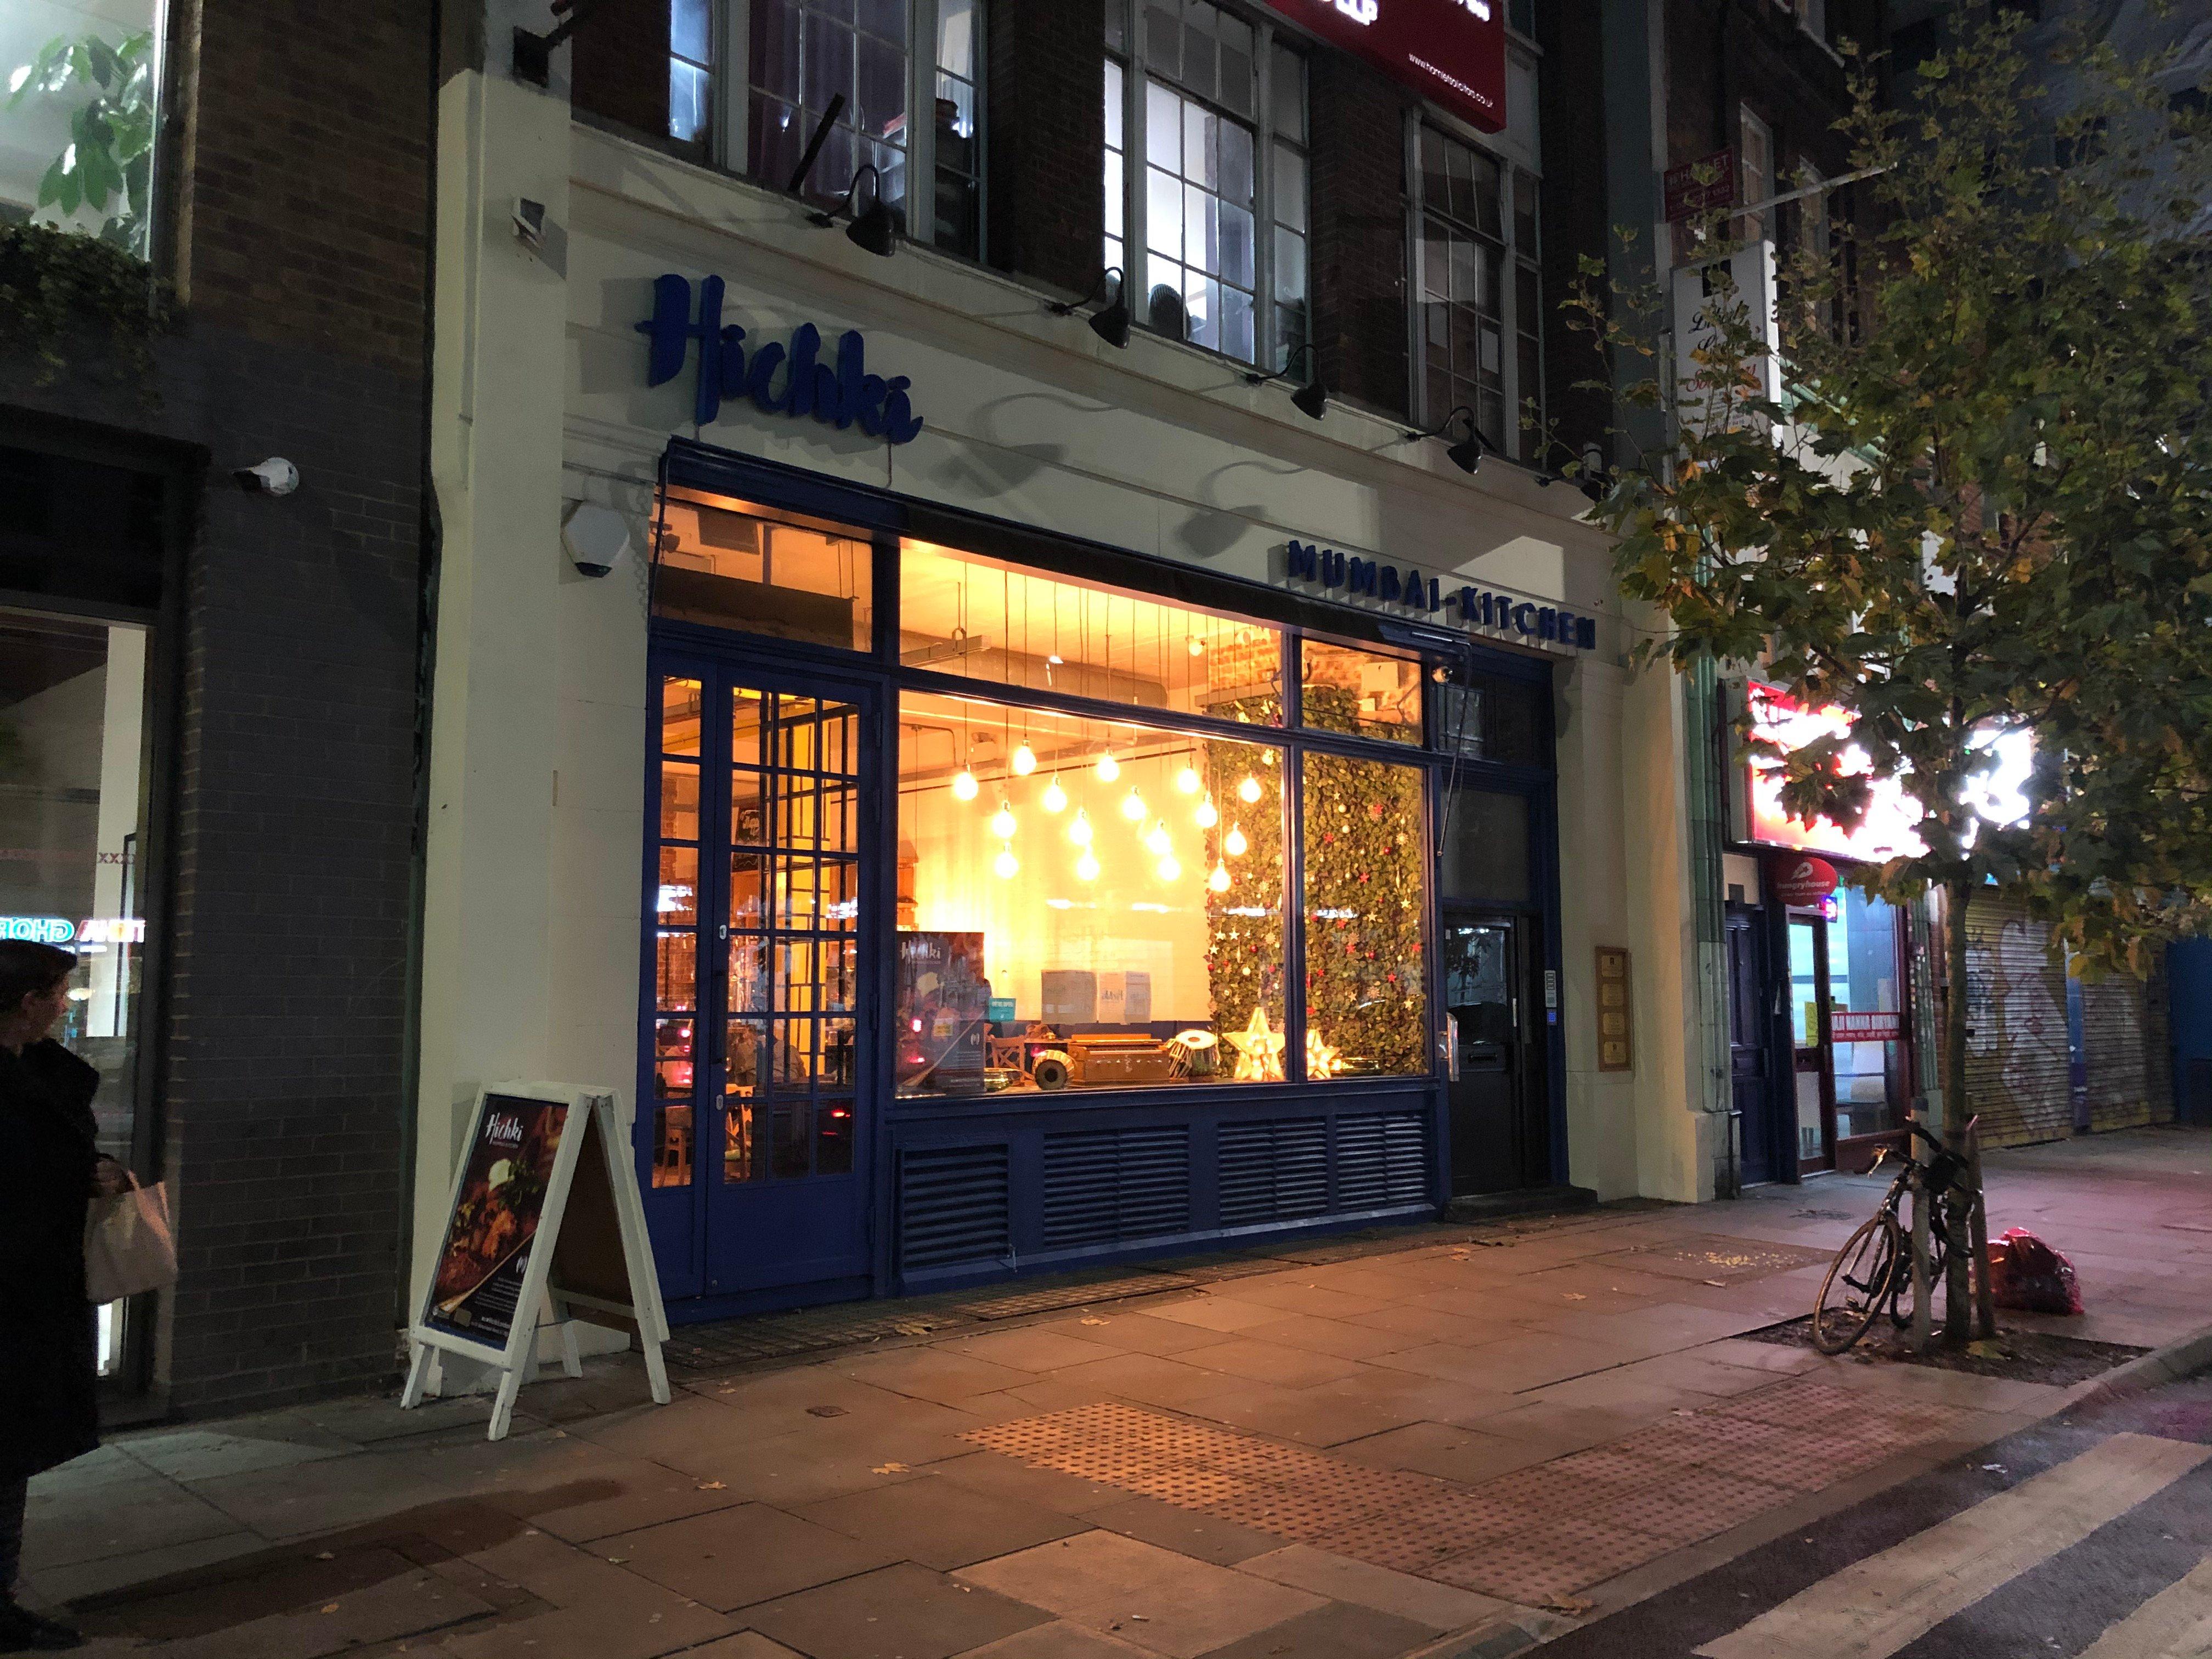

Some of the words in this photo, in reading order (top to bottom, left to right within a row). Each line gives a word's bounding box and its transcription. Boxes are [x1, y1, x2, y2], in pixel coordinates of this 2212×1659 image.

[634, 274, 924, 445] Hichki
[1462, 585, 1596, 650] KITCHEN
[485, 1111, 524, 1146] Hichki
